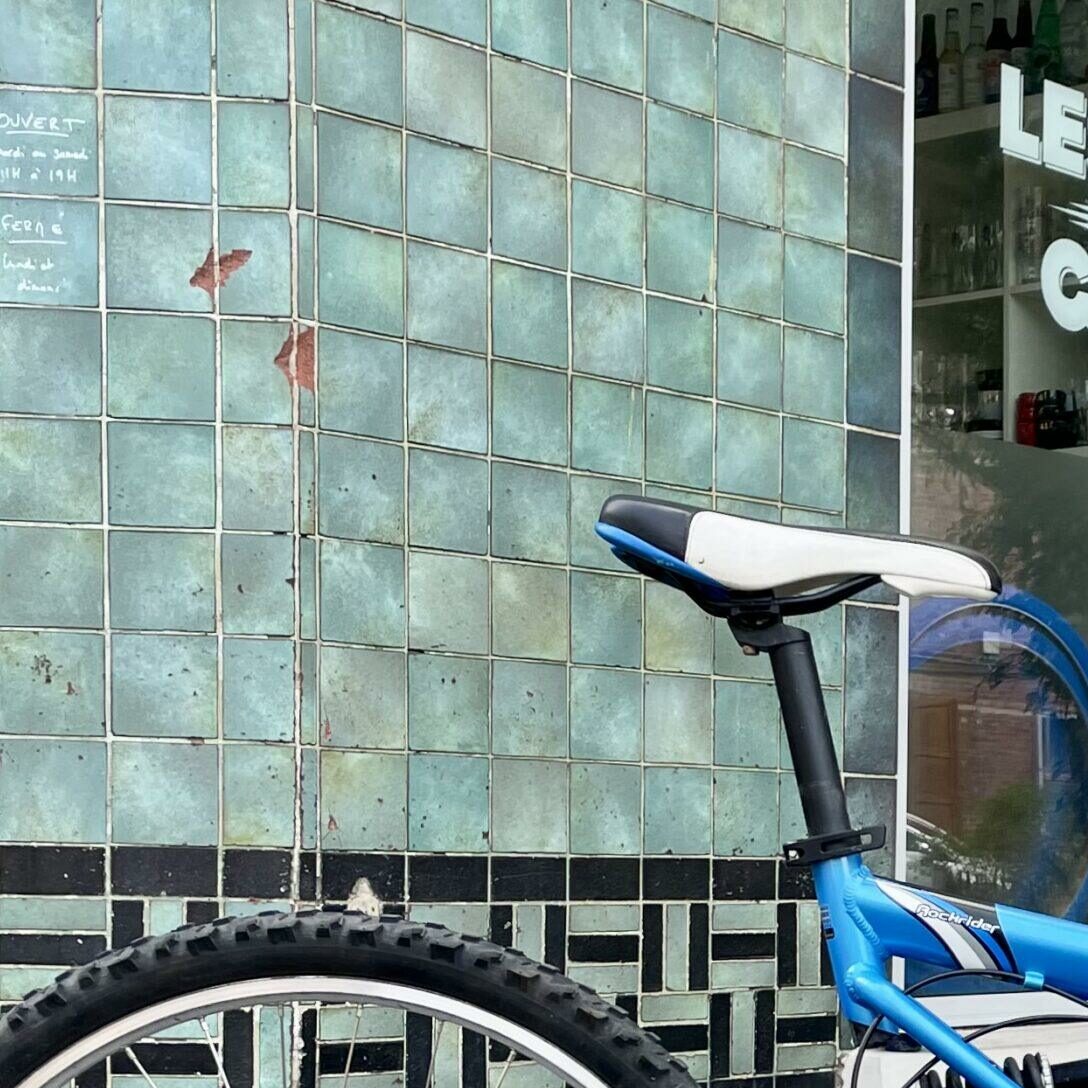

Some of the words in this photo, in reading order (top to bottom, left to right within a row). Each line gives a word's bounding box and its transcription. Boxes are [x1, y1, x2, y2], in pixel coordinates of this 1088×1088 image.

[0, 113, 86, 132] OUVERT
[49, 169, 77, 183] 19H
[915, 904, 1000, 934] Rockrider
